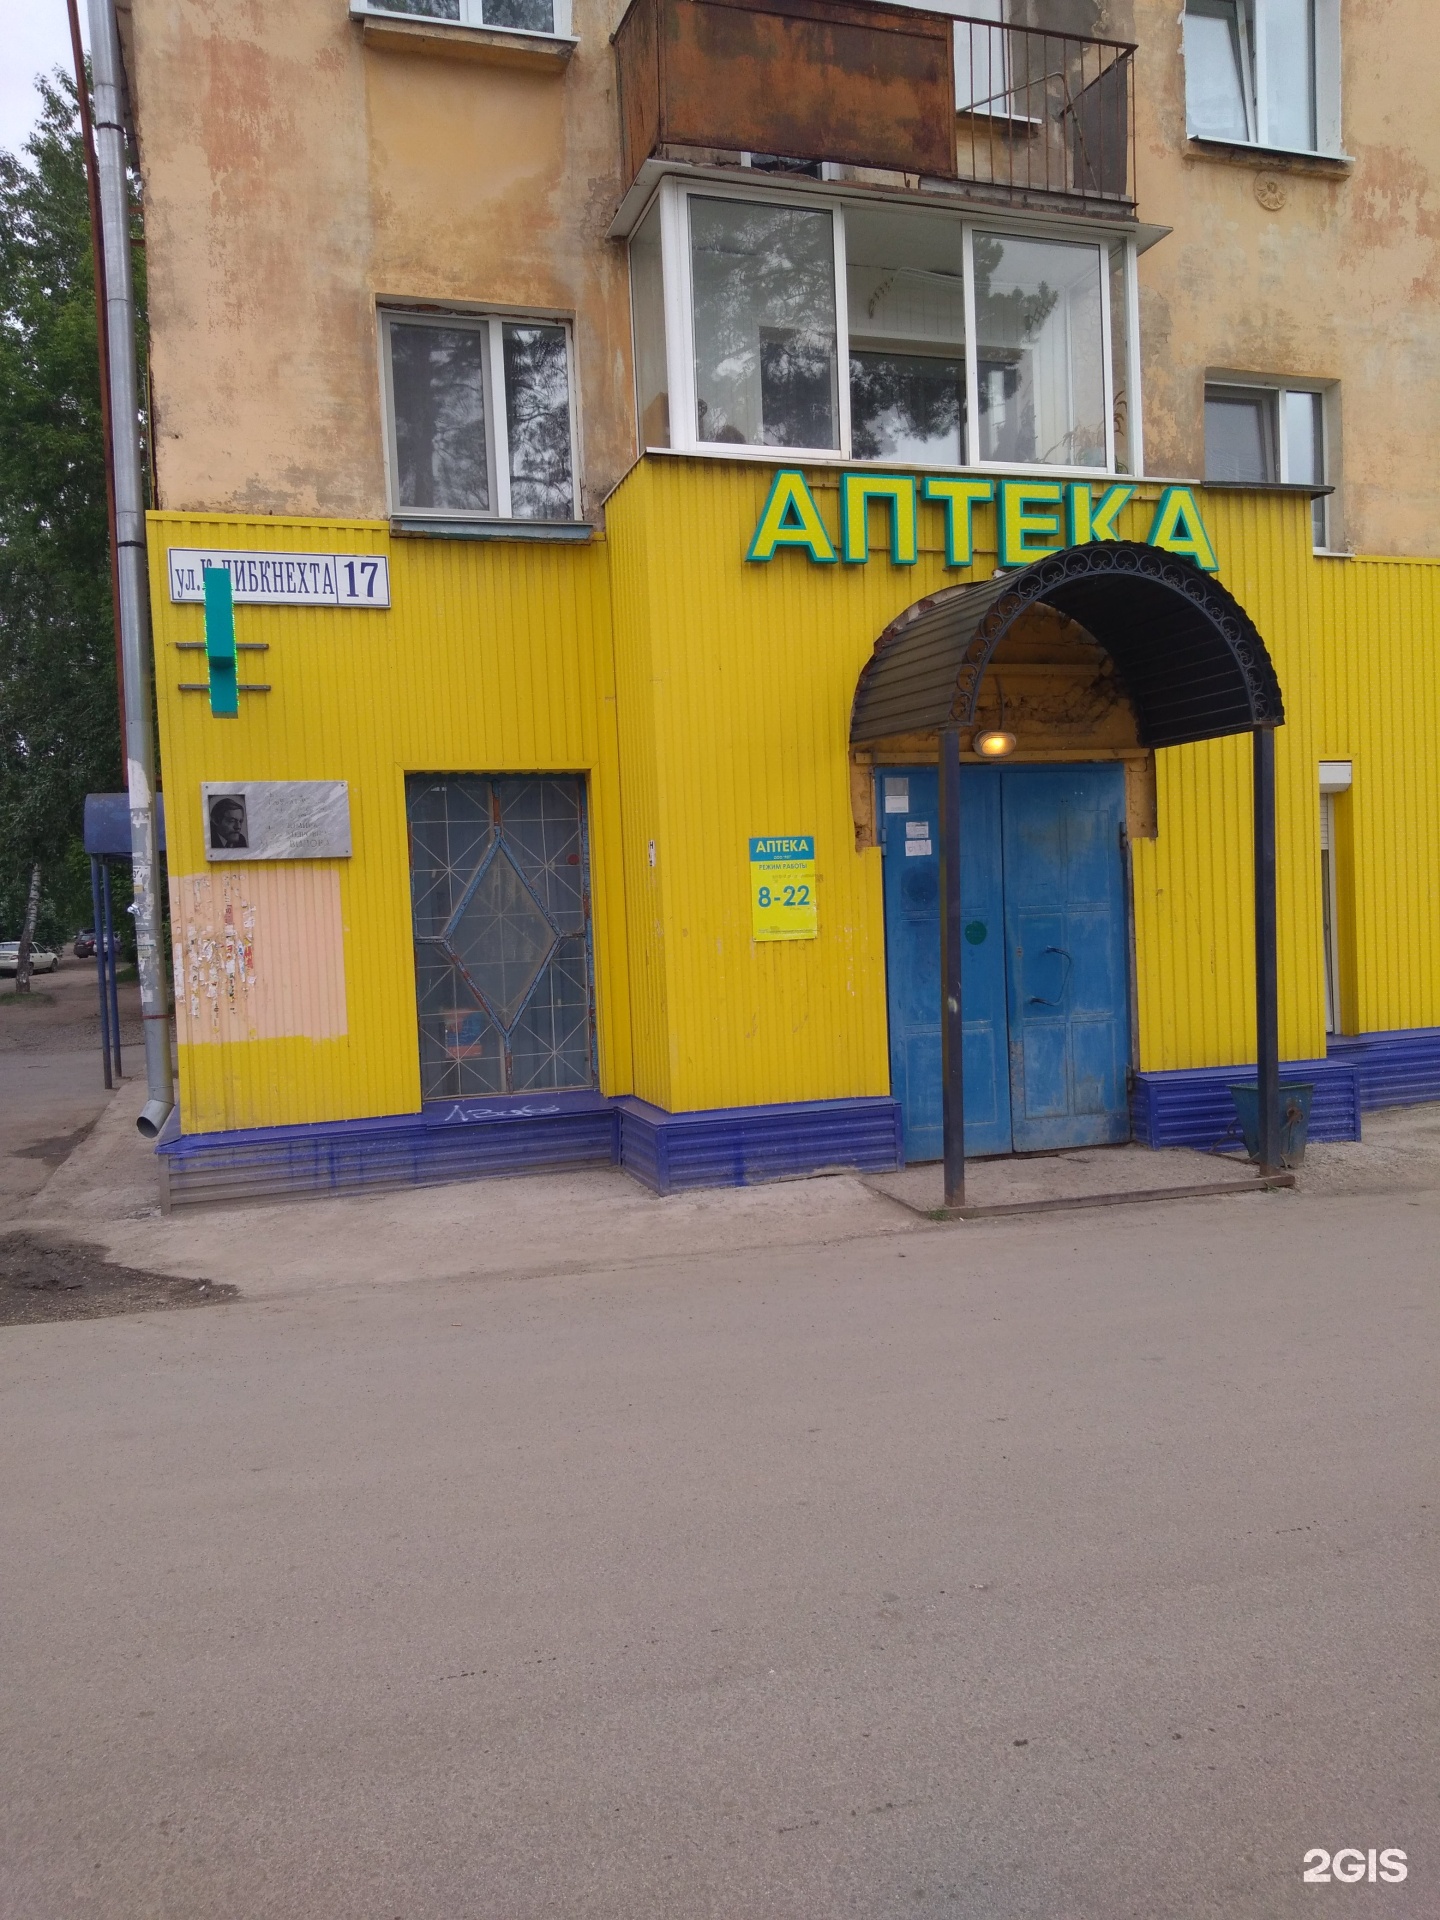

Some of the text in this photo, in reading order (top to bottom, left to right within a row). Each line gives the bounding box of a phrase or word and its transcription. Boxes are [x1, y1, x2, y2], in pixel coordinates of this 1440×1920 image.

[745, 469, 1219, 571] АПТЕКА
[343, 561, 379, 598] 17
[755, 839, 810, 853] АПТЕКА
[758, 885, 810, 908] 8-22
